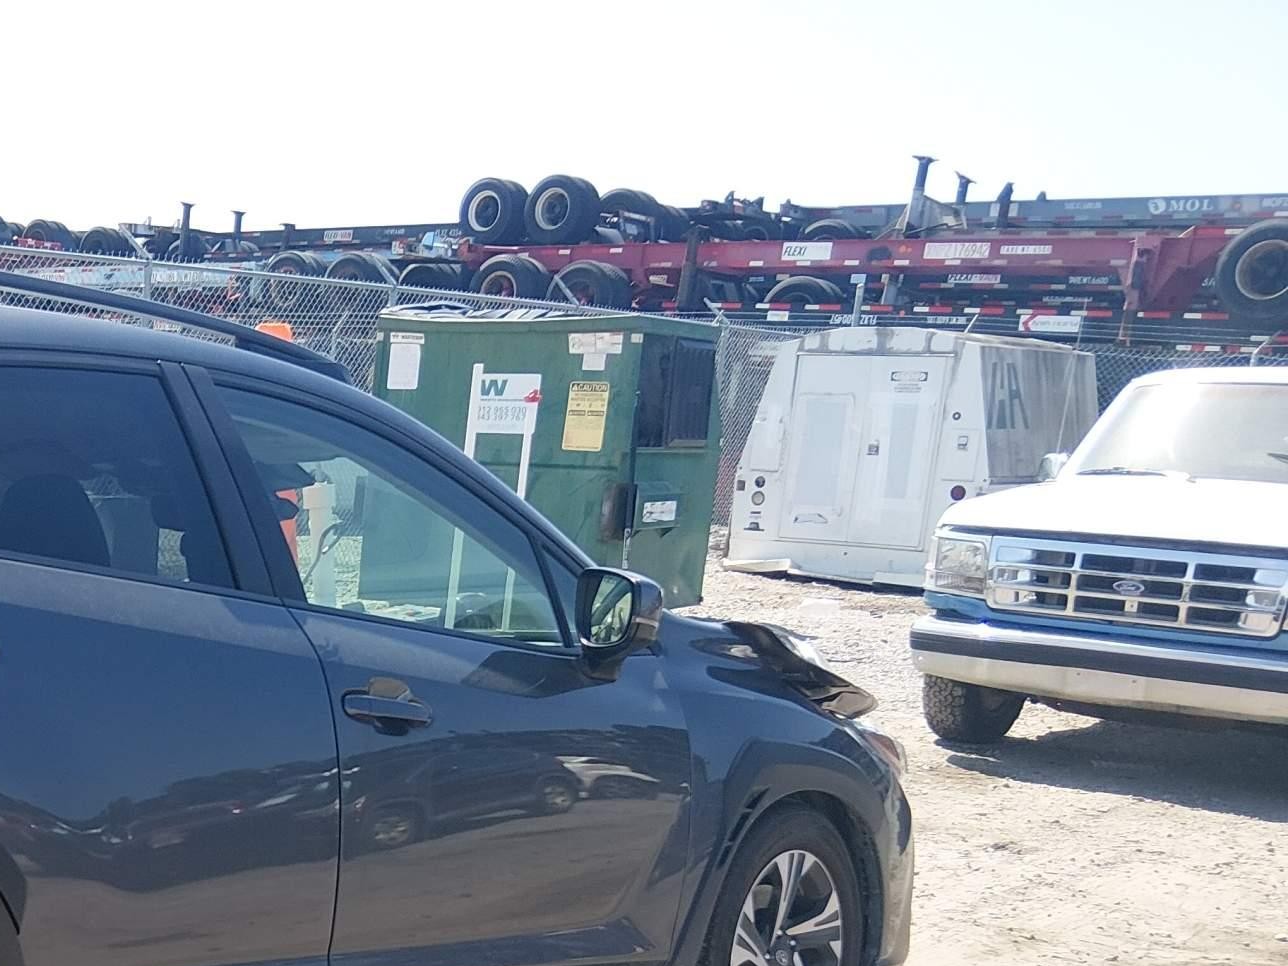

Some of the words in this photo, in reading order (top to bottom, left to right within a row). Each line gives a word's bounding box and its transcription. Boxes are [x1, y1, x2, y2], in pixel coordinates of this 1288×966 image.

[1168, 199, 1214, 213] MOL
[783, 245, 807, 257] FLEXI
[578, 384, 607, 392] CAUTION
